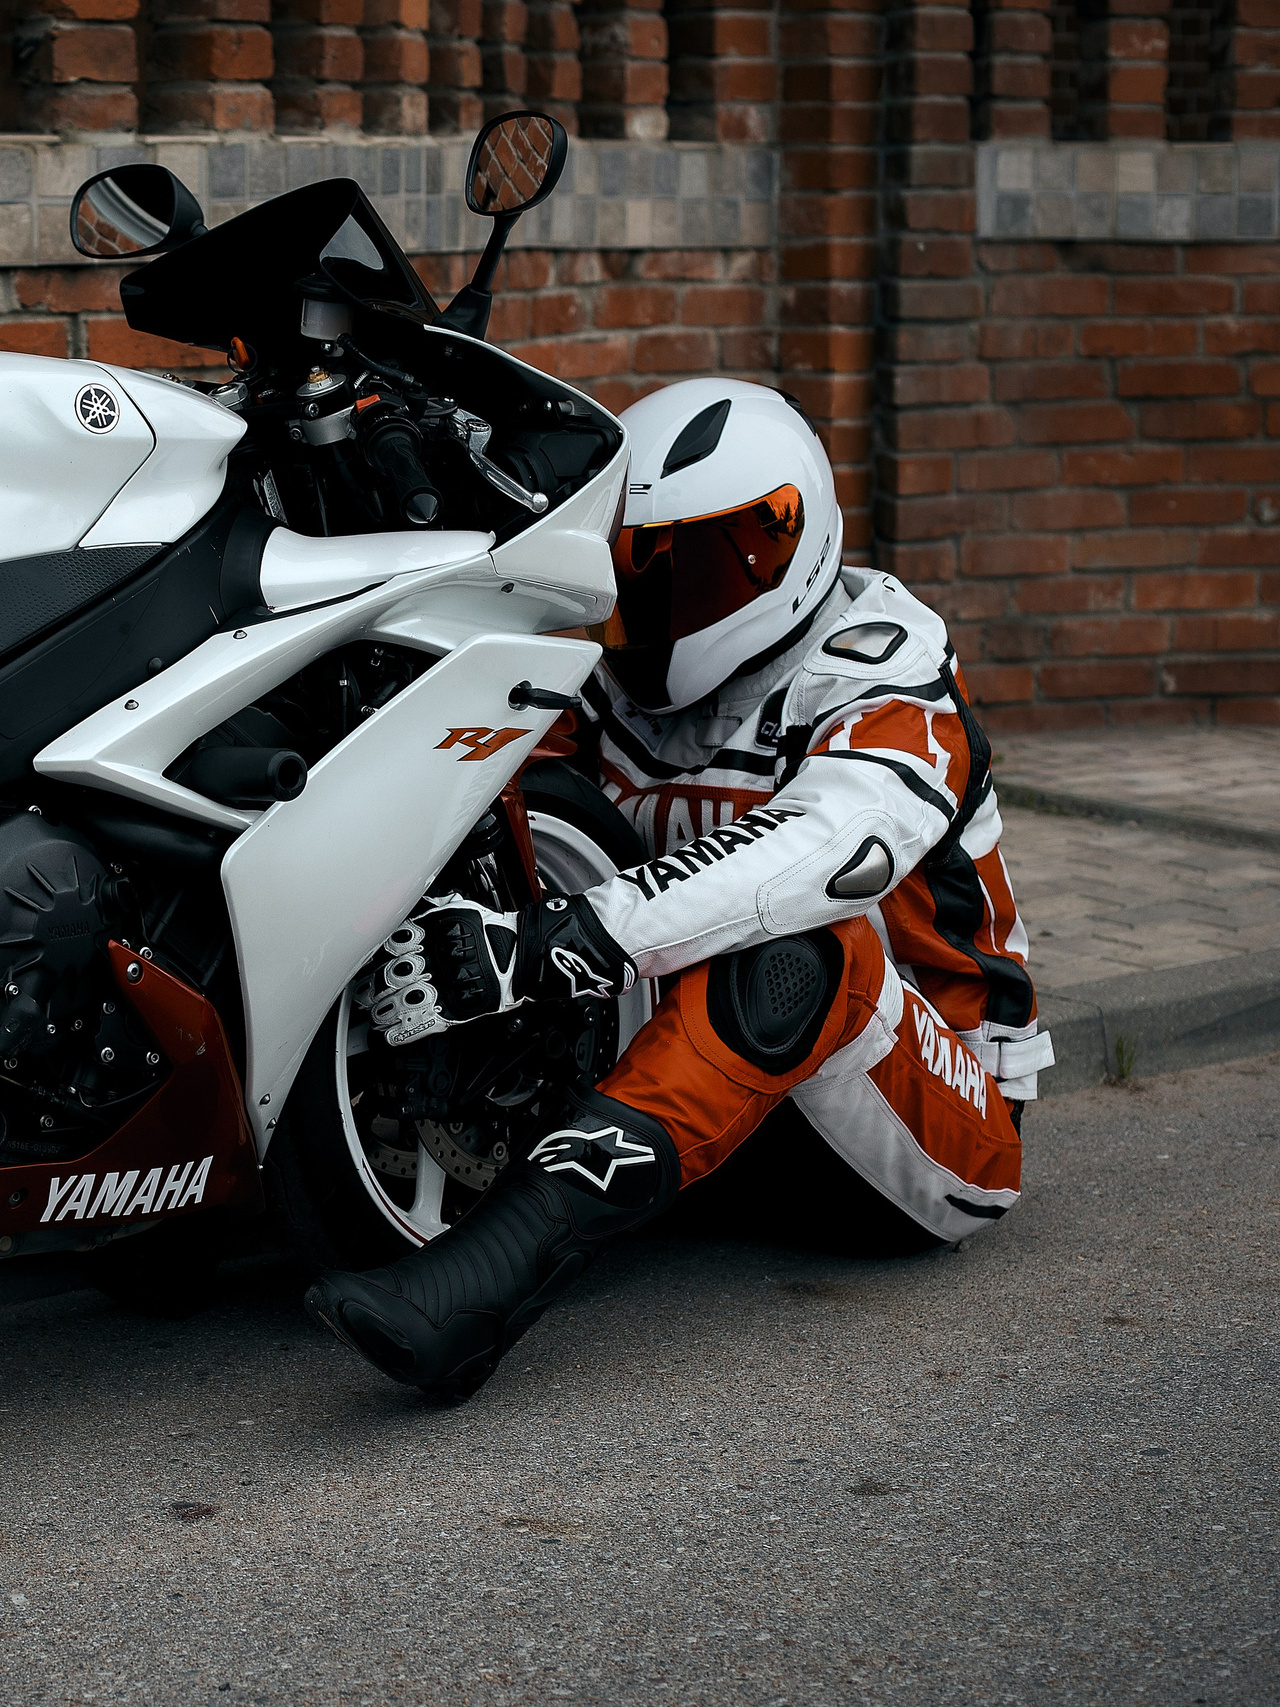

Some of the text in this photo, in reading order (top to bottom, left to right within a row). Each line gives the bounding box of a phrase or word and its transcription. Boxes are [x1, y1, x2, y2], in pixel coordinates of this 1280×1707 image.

[433, 726, 535, 761] R1
[615, 808, 807, 901] YAMAHA
[47, 920, 91, 941] YAMAHA
[912, 1002, 987, 1120] YAMAHA
[39, 1155, 215, 1224] YAMAHA
